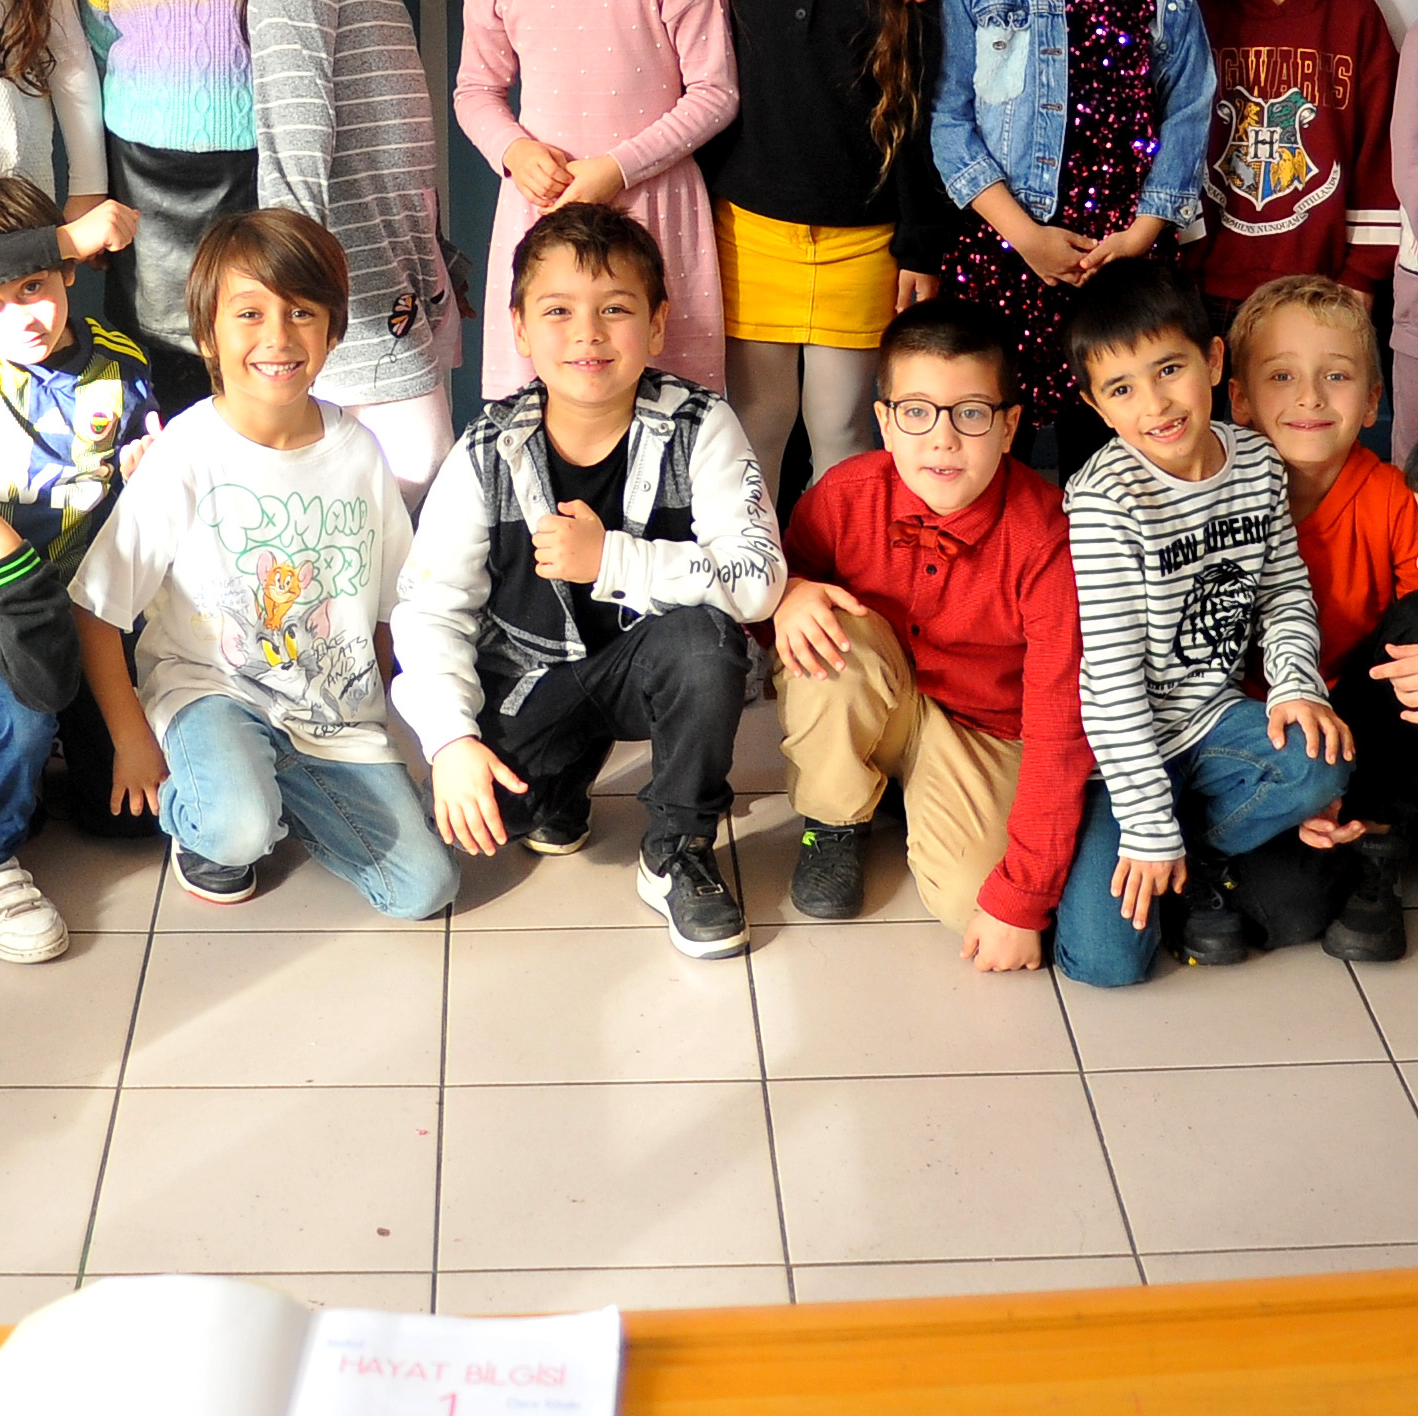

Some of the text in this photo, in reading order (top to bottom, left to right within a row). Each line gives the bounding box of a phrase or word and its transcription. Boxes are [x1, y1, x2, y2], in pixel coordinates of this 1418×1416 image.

[1213, 46, 1353, 110] GWARTS
[1250, 128, 1278, 161] H
[197, 483, 368, 554] TOM AND
[1158, 532, 1198, 578] NEW
[339, 1354, 567, 1387] HAYAT BİLGİSİ
